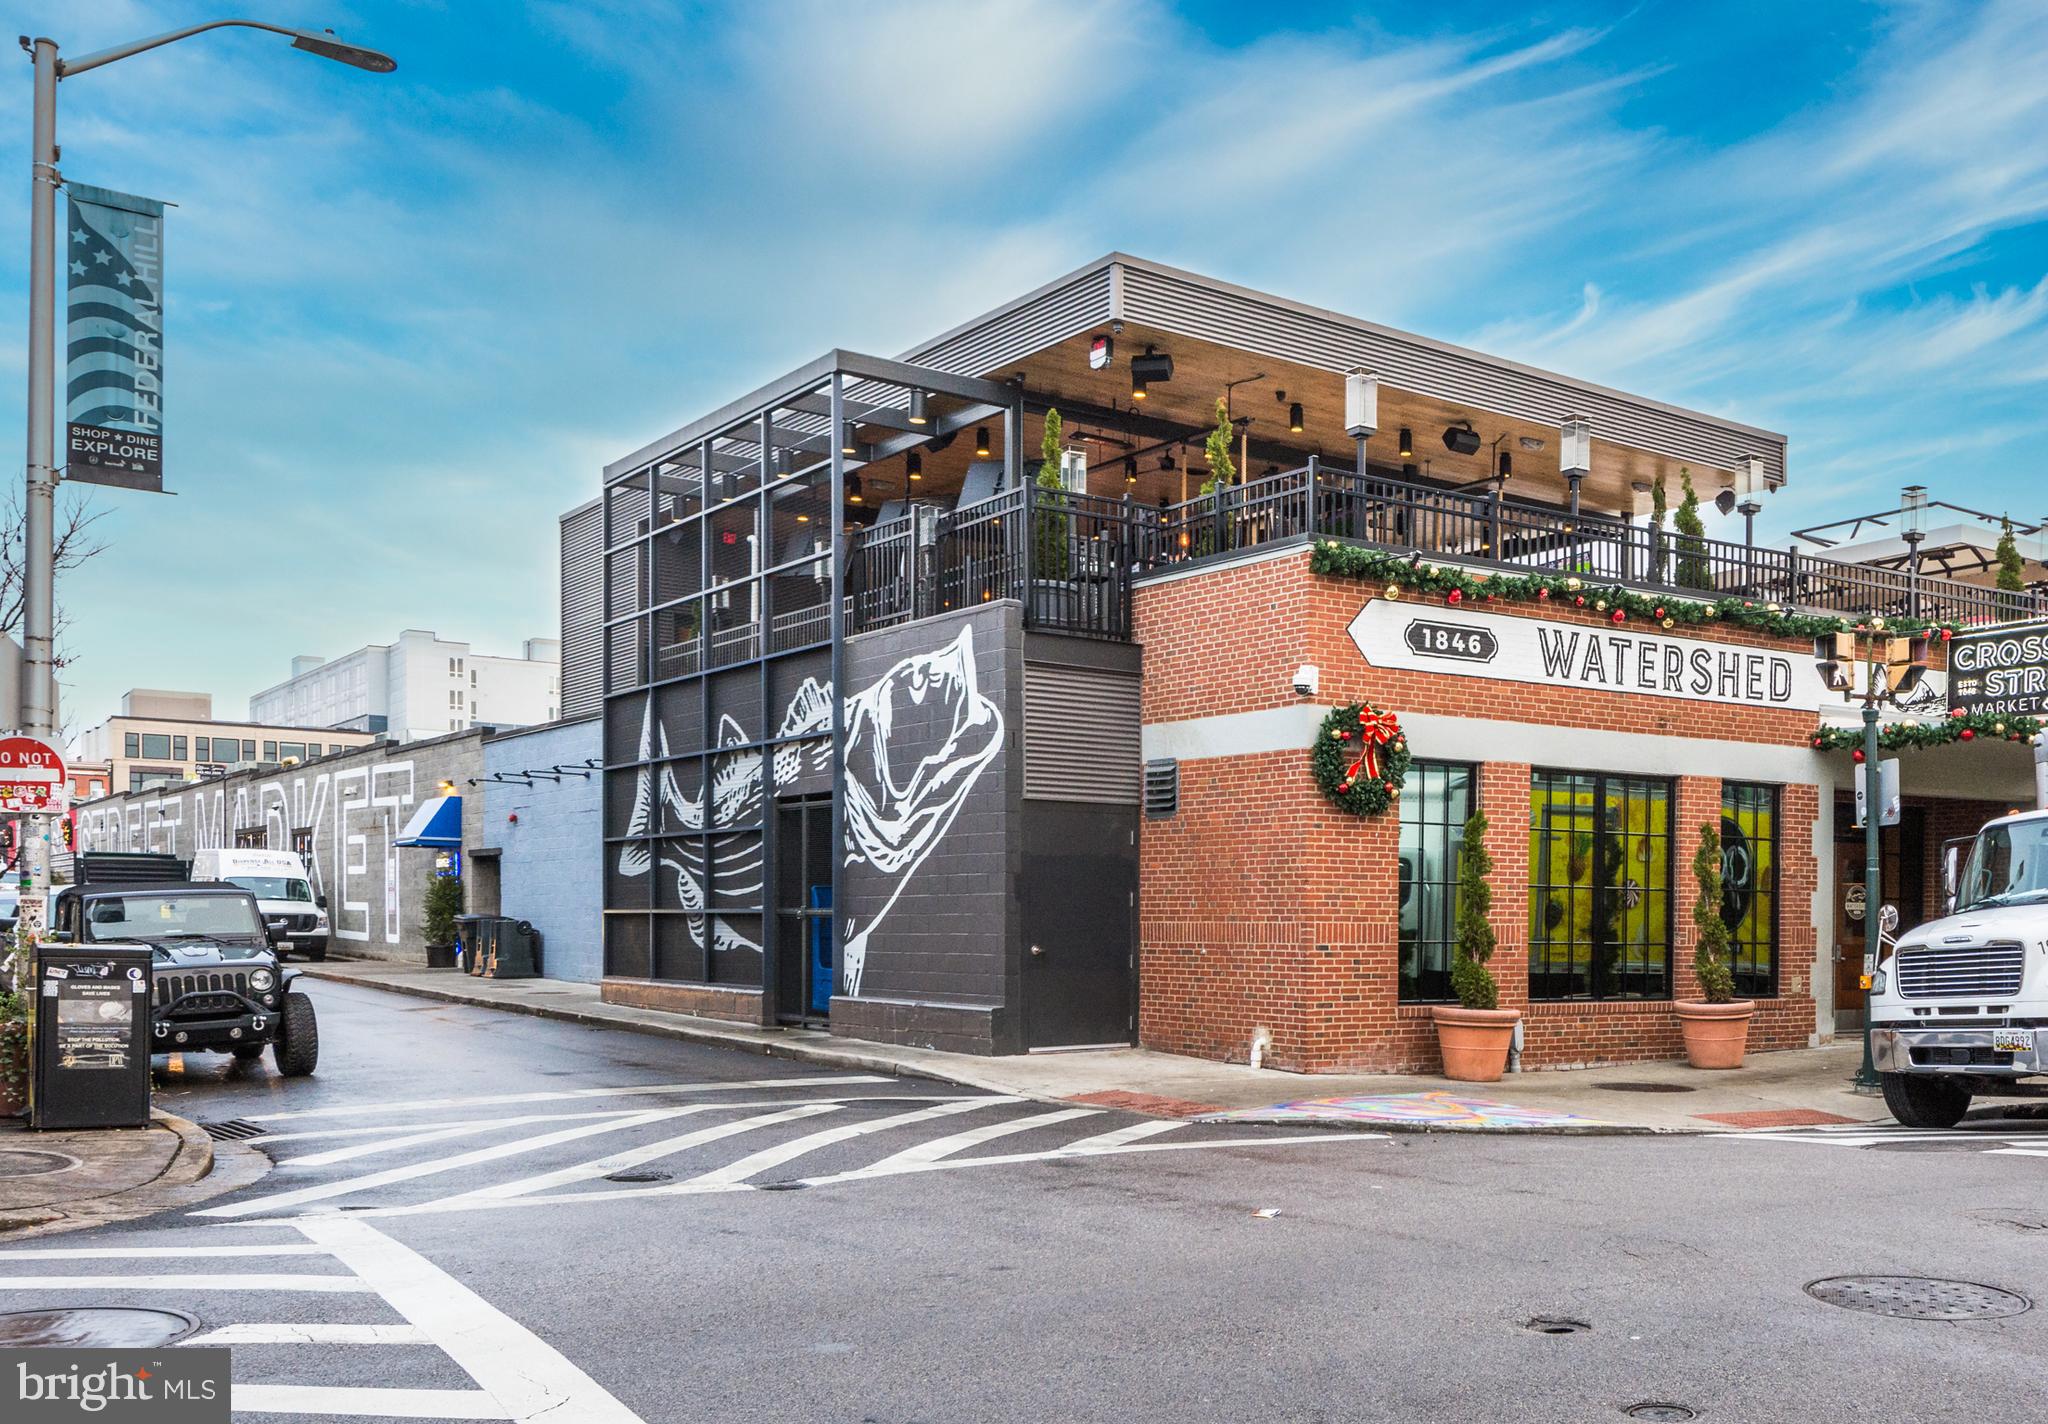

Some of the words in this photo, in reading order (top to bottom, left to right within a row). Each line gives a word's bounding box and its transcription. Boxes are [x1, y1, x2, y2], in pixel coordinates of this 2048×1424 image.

[134, 219, 158, 285] HILL
[134, 289, 158, 430] FEDERAL
[71, 427, 110, 440] SHOP
[127, 434, 158, 448] DINE
[71, 439, 158, 462] EXPLORE
[1422, 627, 1481, 654] 1846
[1537, 627, 1793, 703] WATERSHED
[1971, 697, 2041, 716] MARKET
[19, 752, 52, 765] NOT
[2037, 940, 2048, 955] 1
